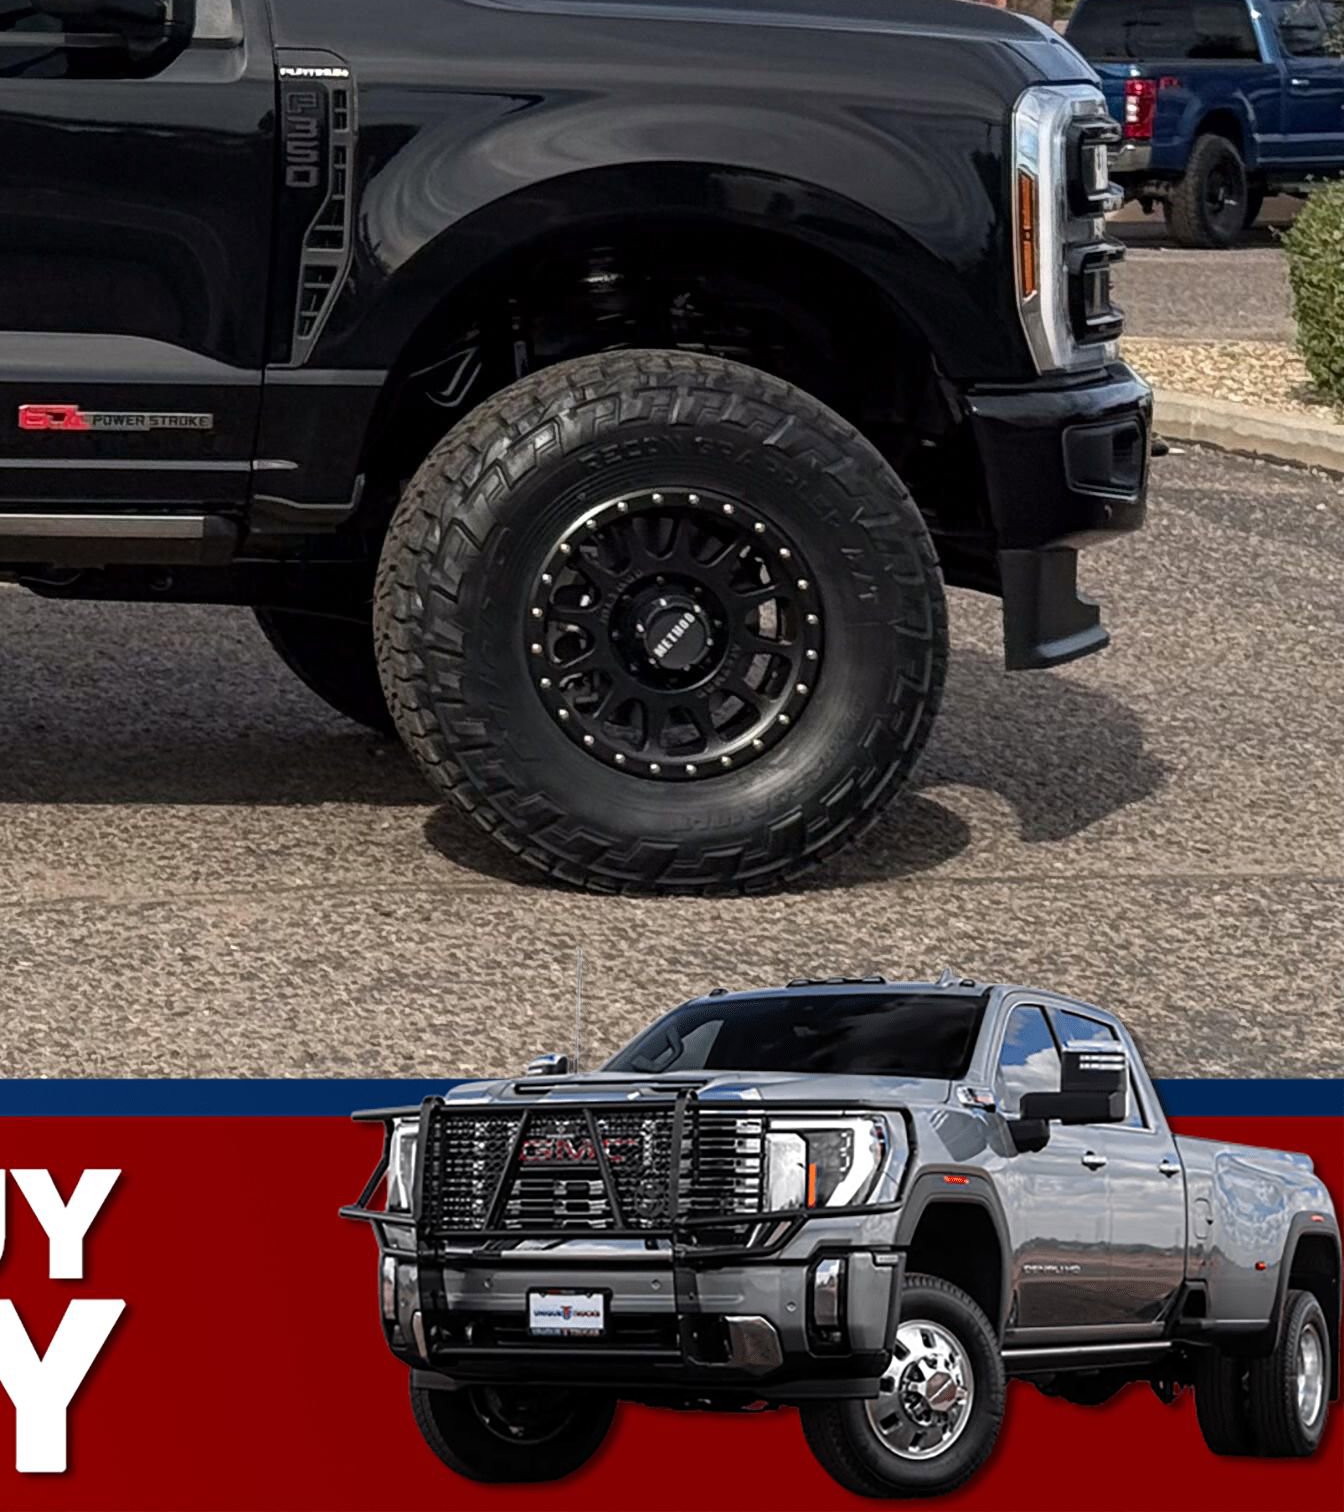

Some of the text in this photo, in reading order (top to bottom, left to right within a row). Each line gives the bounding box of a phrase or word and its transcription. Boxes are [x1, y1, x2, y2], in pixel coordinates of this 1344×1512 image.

[285, 91, 319, 188] F350
[93, 414, 146, 427] POWER
[148, 414, 209, 427] STROKE
[652, 611, 696, 659] METHOD
